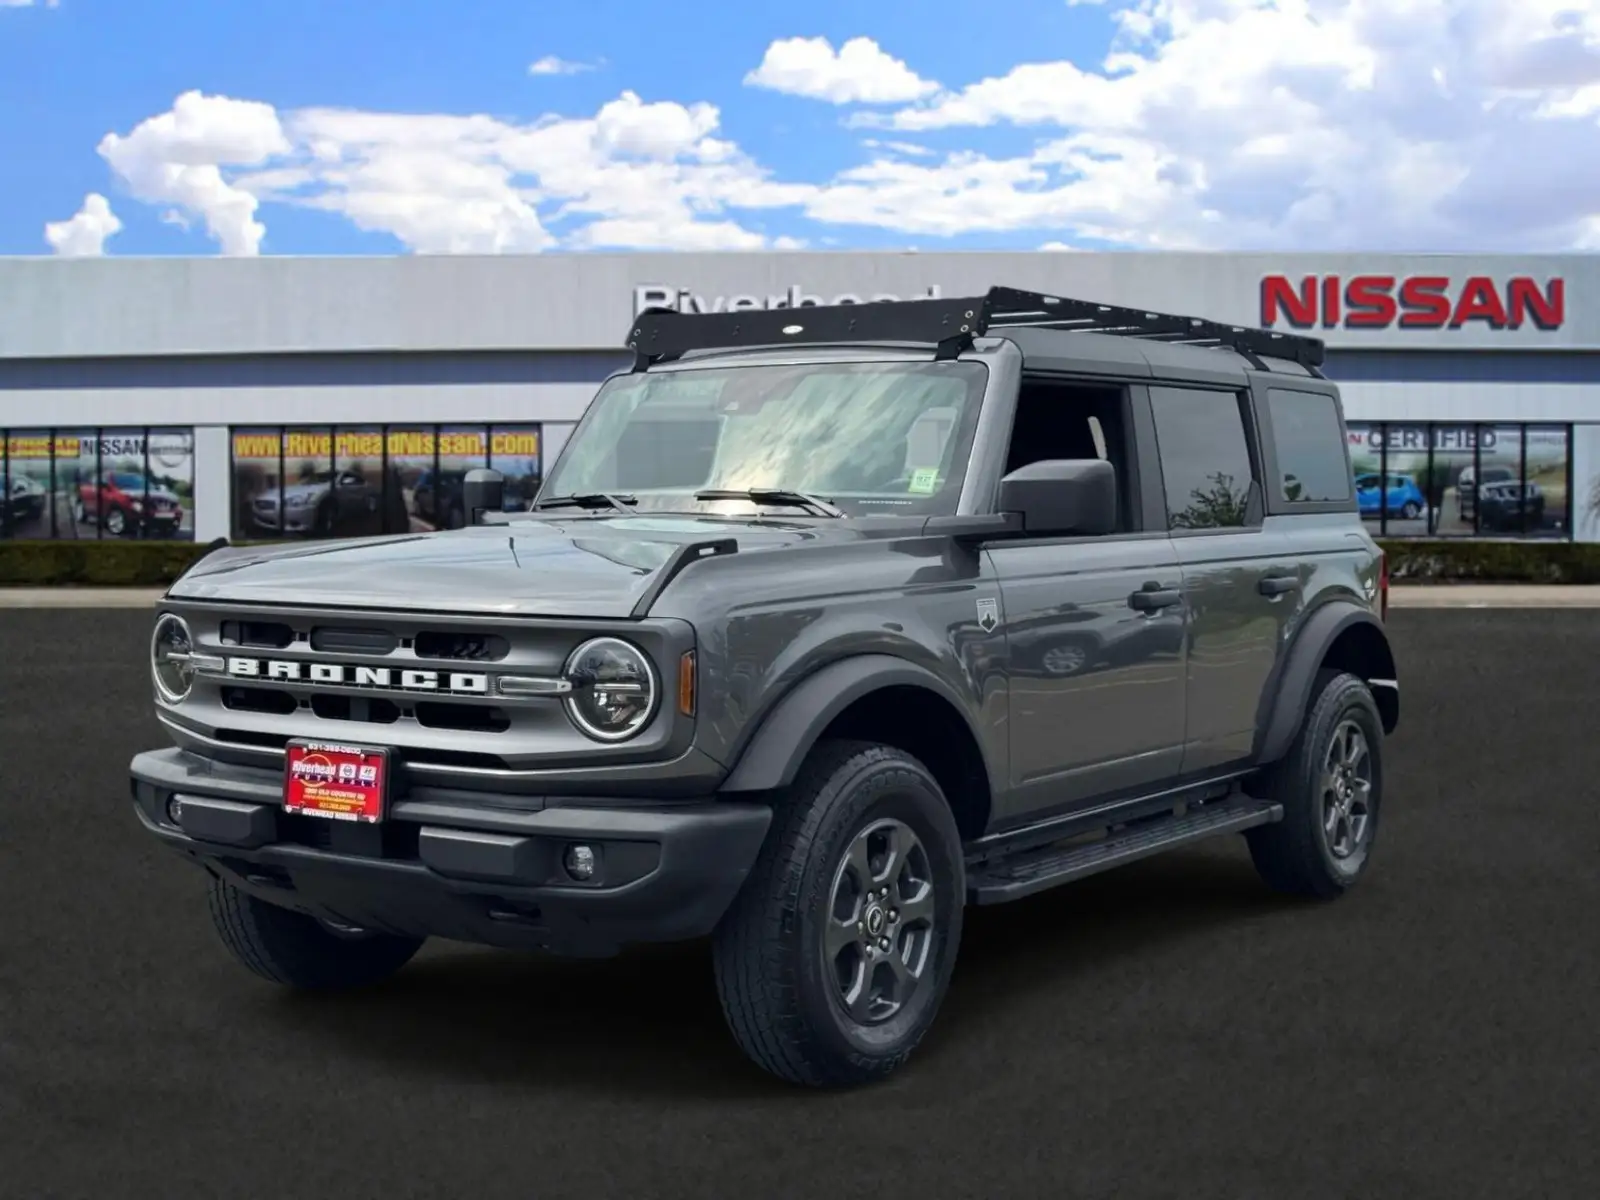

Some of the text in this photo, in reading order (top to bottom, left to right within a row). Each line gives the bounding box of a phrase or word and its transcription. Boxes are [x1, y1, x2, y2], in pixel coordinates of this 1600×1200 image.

[1261, 275, 1565, 330] NISSAN
[229, 657, 488, 693] BRONCO
[292, 760, 336, 776] Riverhead
